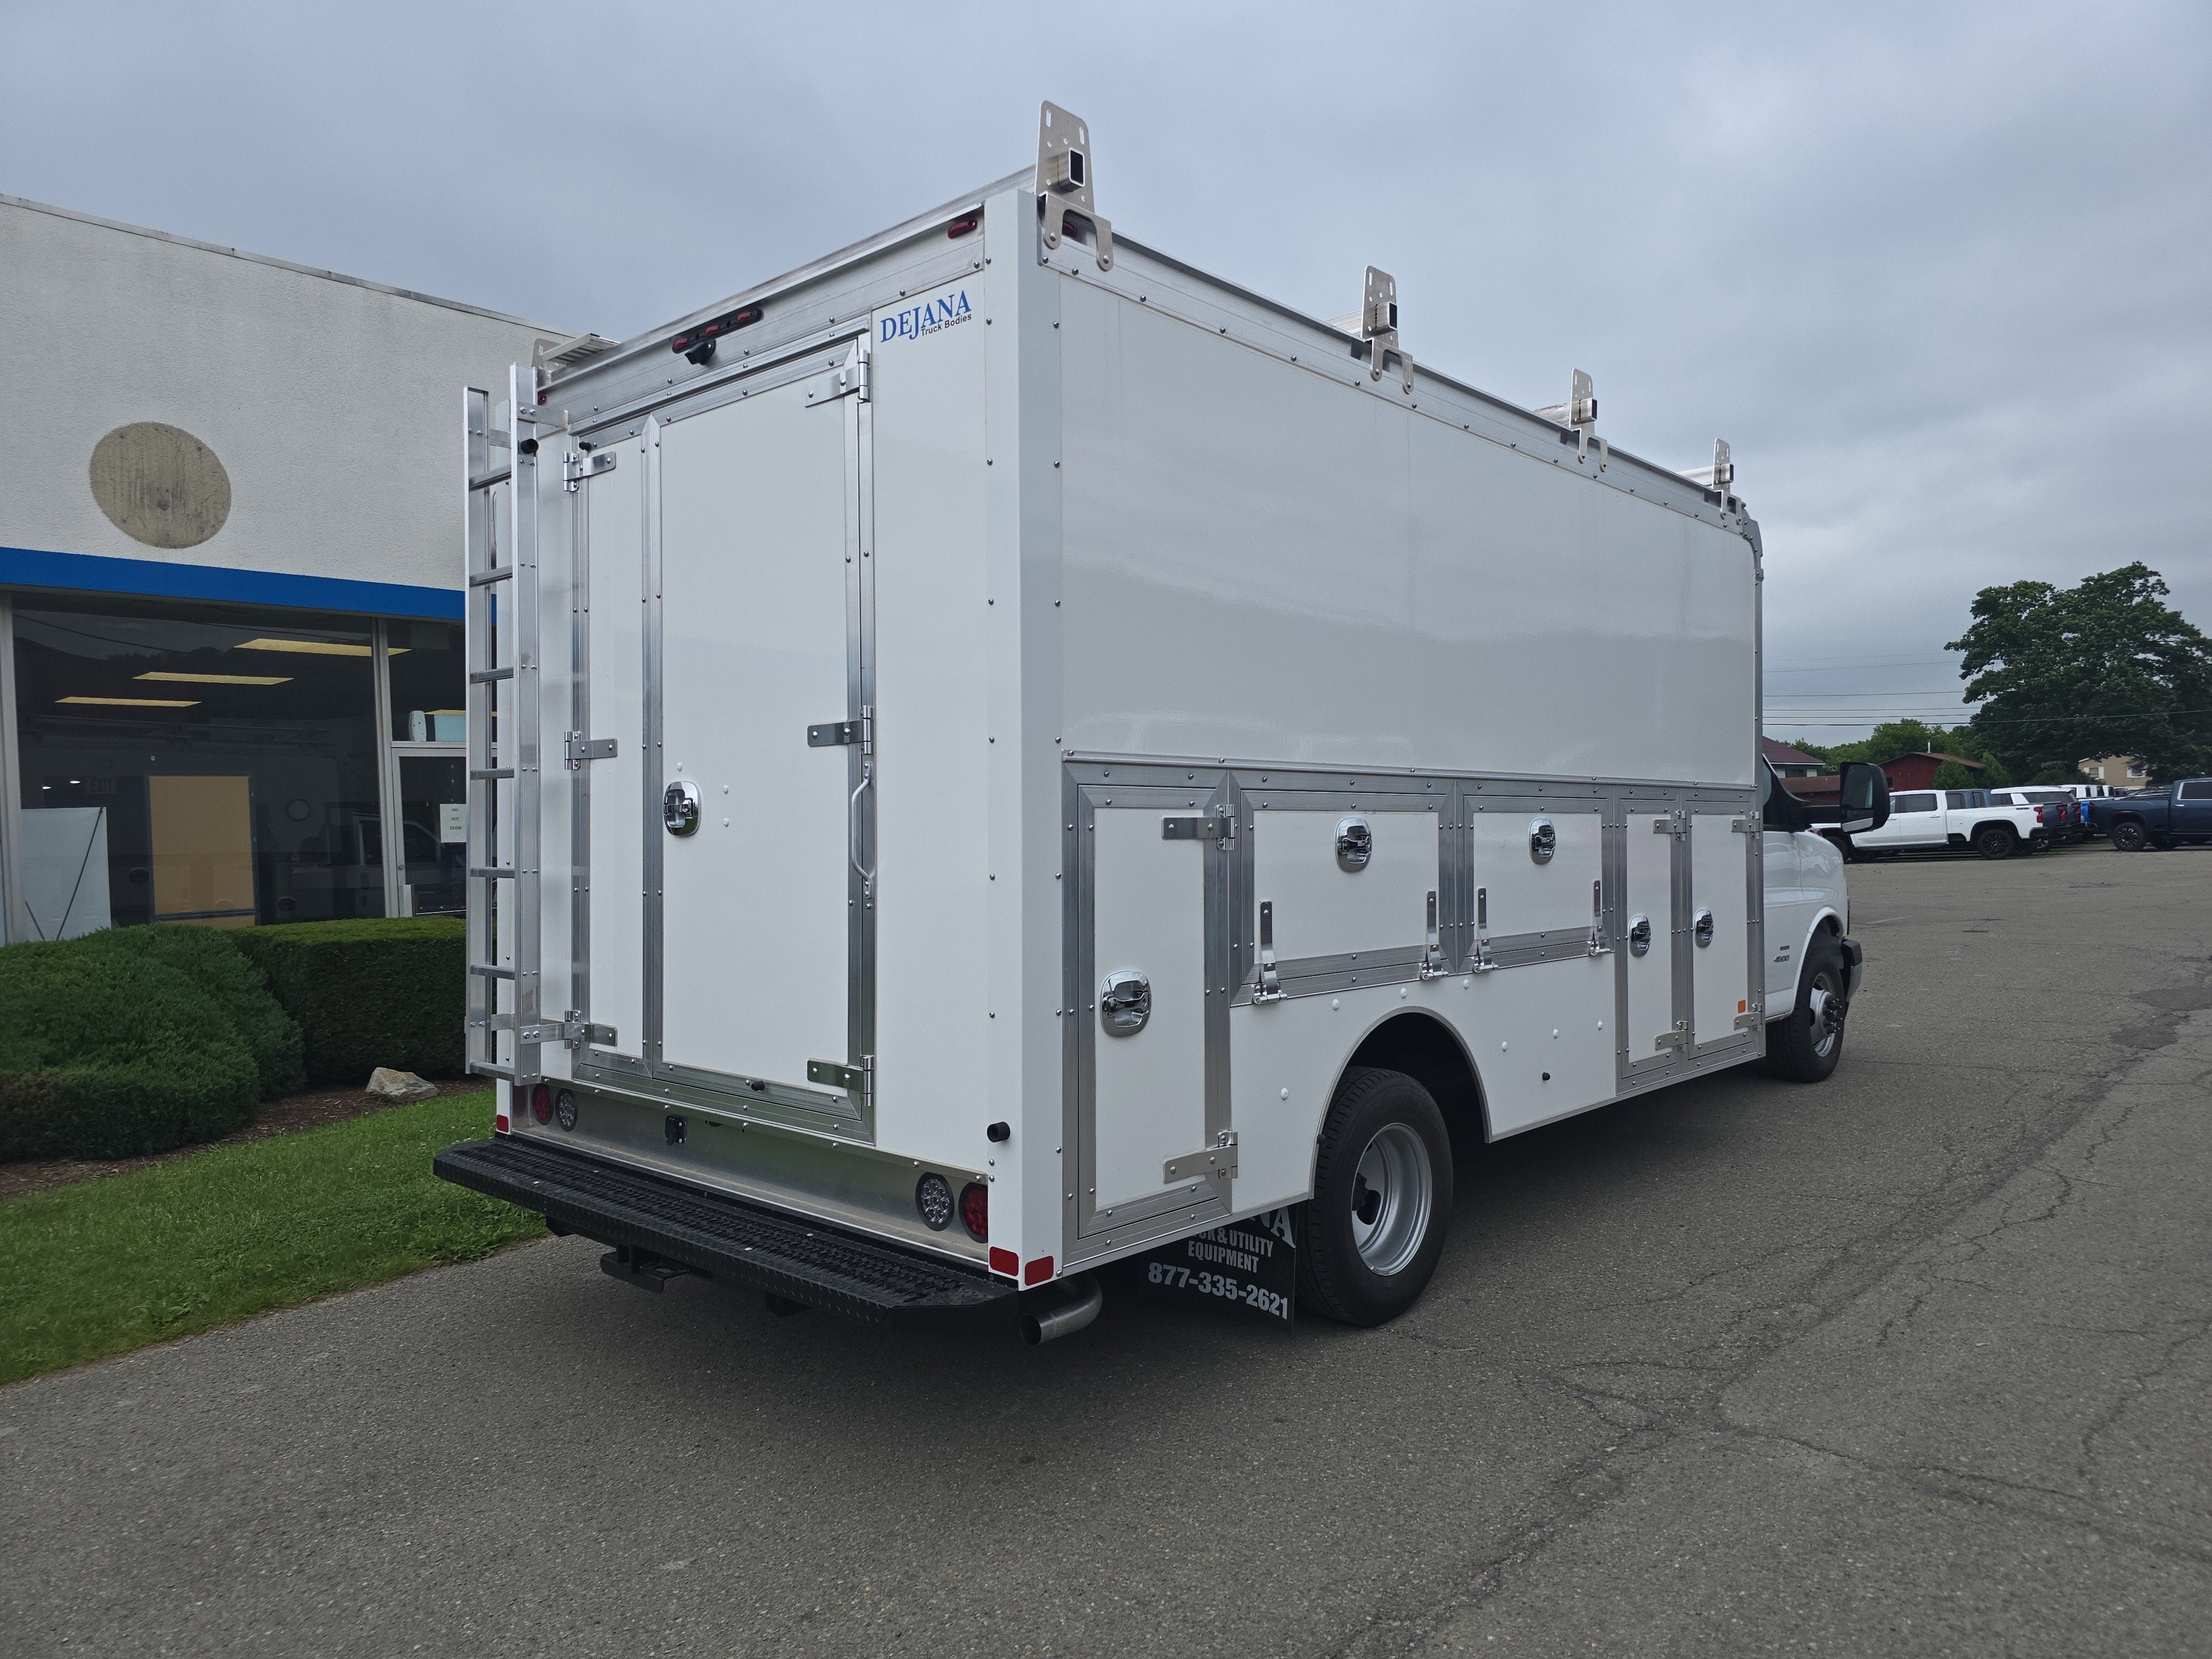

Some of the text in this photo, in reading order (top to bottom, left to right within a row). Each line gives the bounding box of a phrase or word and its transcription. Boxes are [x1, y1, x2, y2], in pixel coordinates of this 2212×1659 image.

[880, 290, 972, 343] DEJANA
[921, 313, 972, 337] Truck Bodies
[90, 779, 112, 792] EXIT
[1187, 1240, 1259, 1273] EQUIPMENT
[1217, 1227, 1228, 1244] &
[1229, 1229, 1274, 1258] UTILITY
[1148, 1262, 1288, 1320] 877-335-2621
